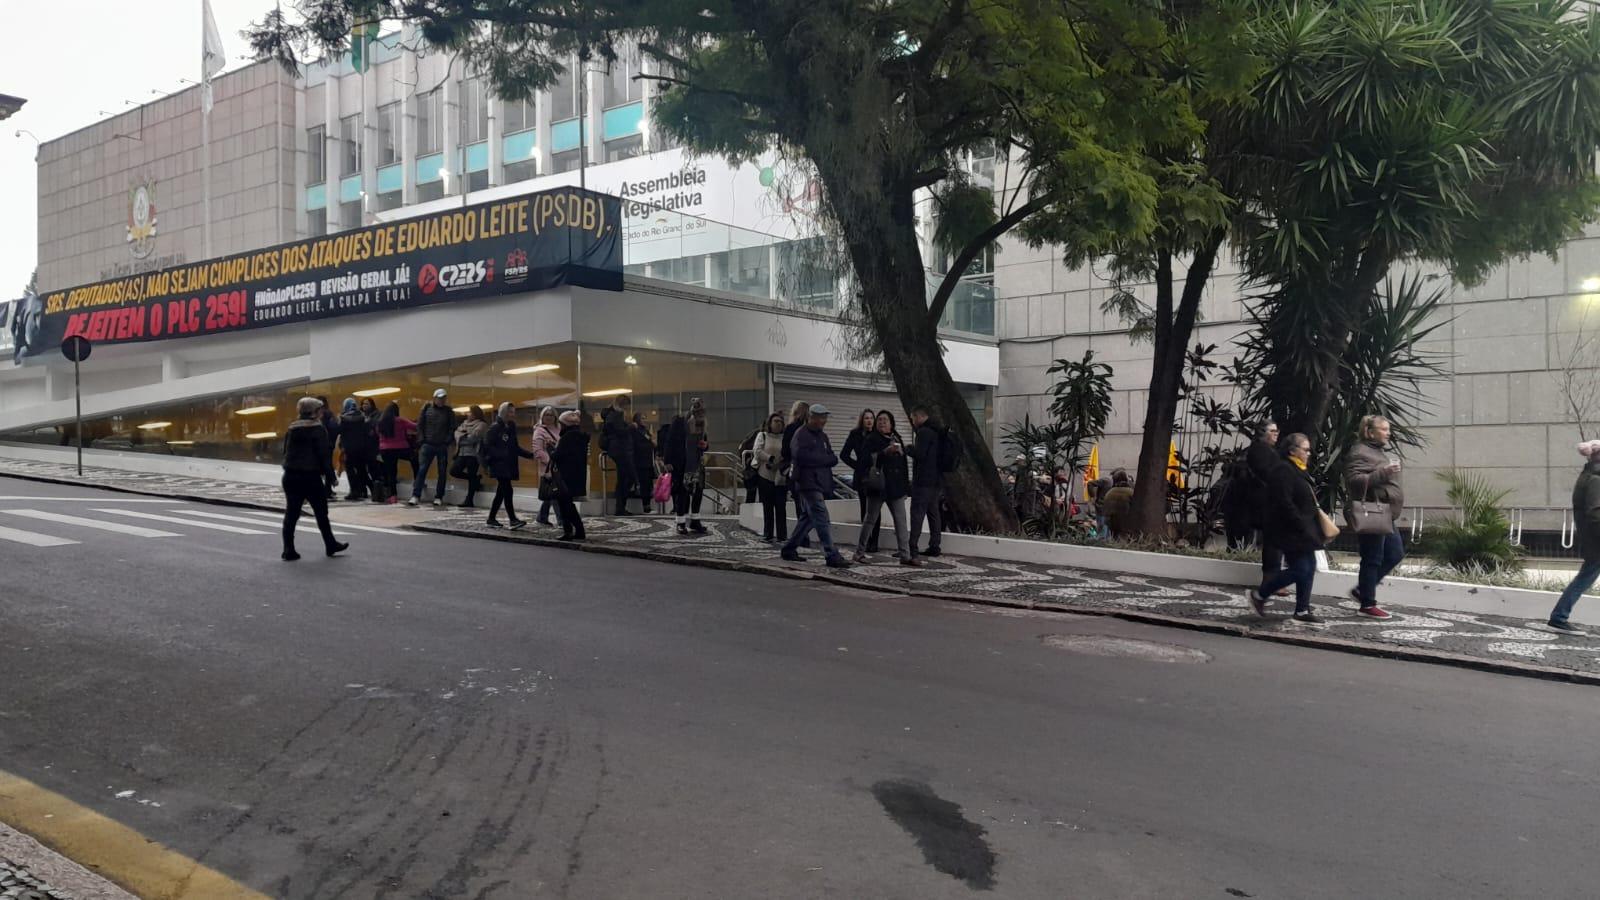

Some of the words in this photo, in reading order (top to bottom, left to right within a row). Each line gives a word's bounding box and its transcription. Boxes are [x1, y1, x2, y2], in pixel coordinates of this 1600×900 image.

[620, 167, 706, 197] Assembleia
[622, 191, 702, 219] Legislativa
[170, 264, 208, 294] SEJAM
[281, 243, 308, 275] DOS
[308, 230, 372, 268] ATAQUES
[374, 226, 395, 257] DE
[397, 210, 476, 254] EDUARDO
[479, 199, 529, 239] LEITE
[320, 272, 359, 296] REVISÃO
[360, 269, 391, 289] GERAL
[394, 263, 410, 285] JÁ!
[62, 305, 145, 340] REJEITEM
[150, 303, 163, 336] O
[167, 297, 200, 334] PLC
[205, 289, 247, 329] 259!
[254, 304, 292, 321] EDUARDO
[329, 298, 334, 309] A
[339, 292, 370, 307] CULPA
[375, 288, 380, 303] É
[386, 287, 410, 301] TUA!
